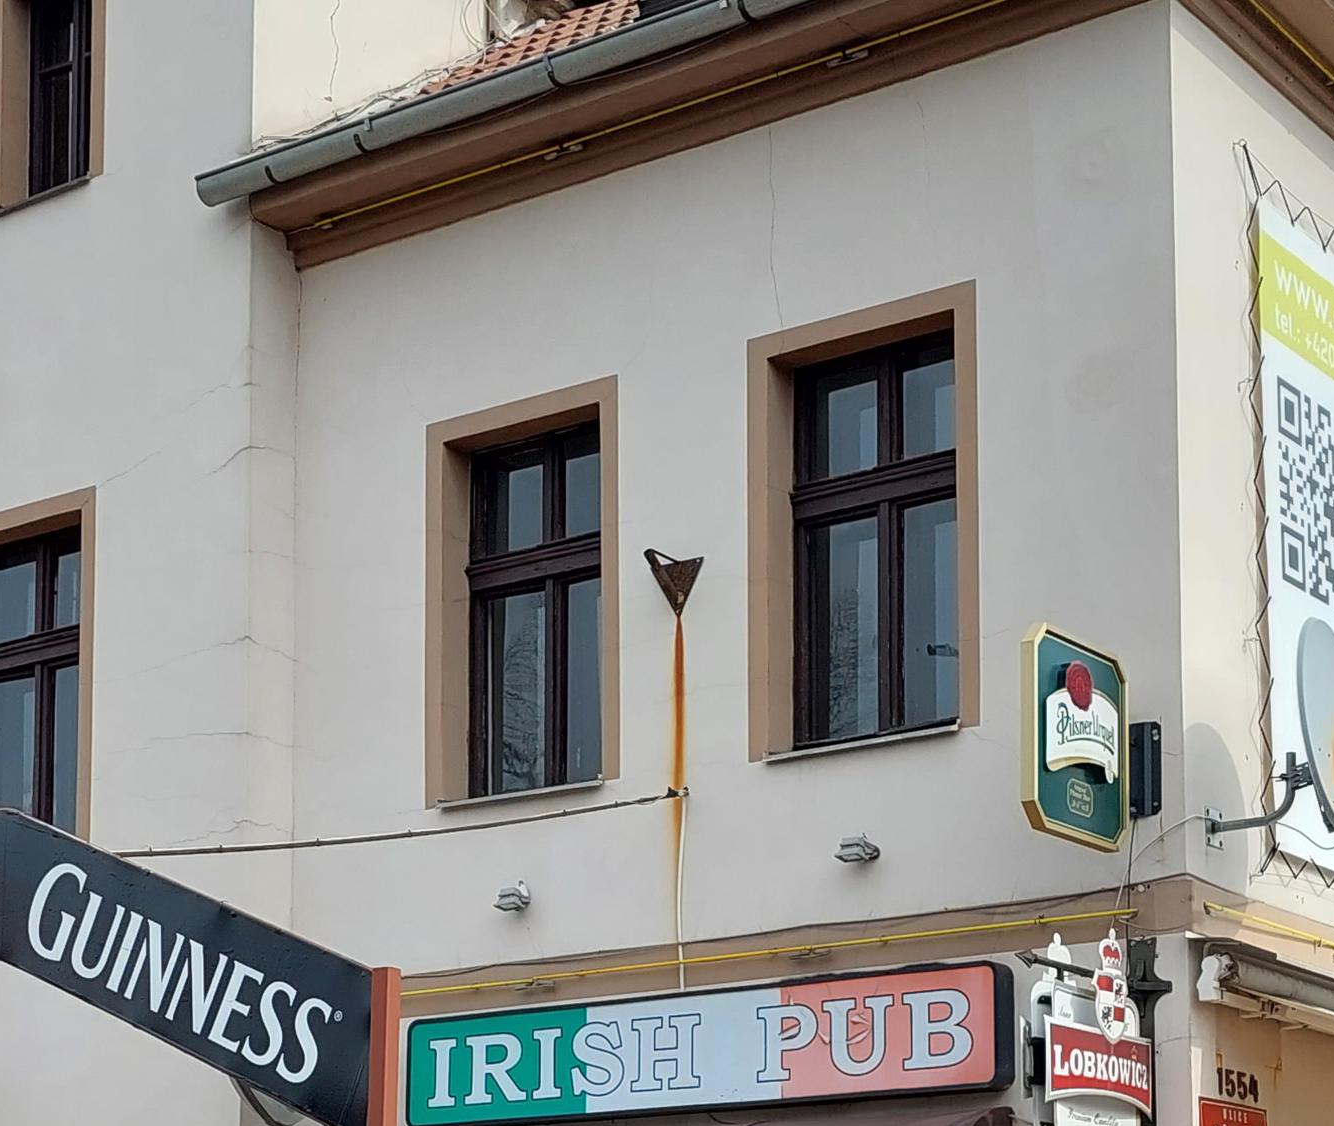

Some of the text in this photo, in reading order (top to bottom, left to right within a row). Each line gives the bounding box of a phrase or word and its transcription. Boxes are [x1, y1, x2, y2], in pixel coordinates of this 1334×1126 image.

[1275, 303, 1301, 343] tel.:
[1056, 702, 1115, 751] Pilsner Urquell
[28, 863, 333, 1083] GUINNESS
[426, 987, 975, 1109] IRISH PUB
[1053, 1044, 1148, 1090] LOBKOWICZ
[1217, 1067, 1259, 1103] 1554
[1222, 1108, 1248, 1124] ULICE
